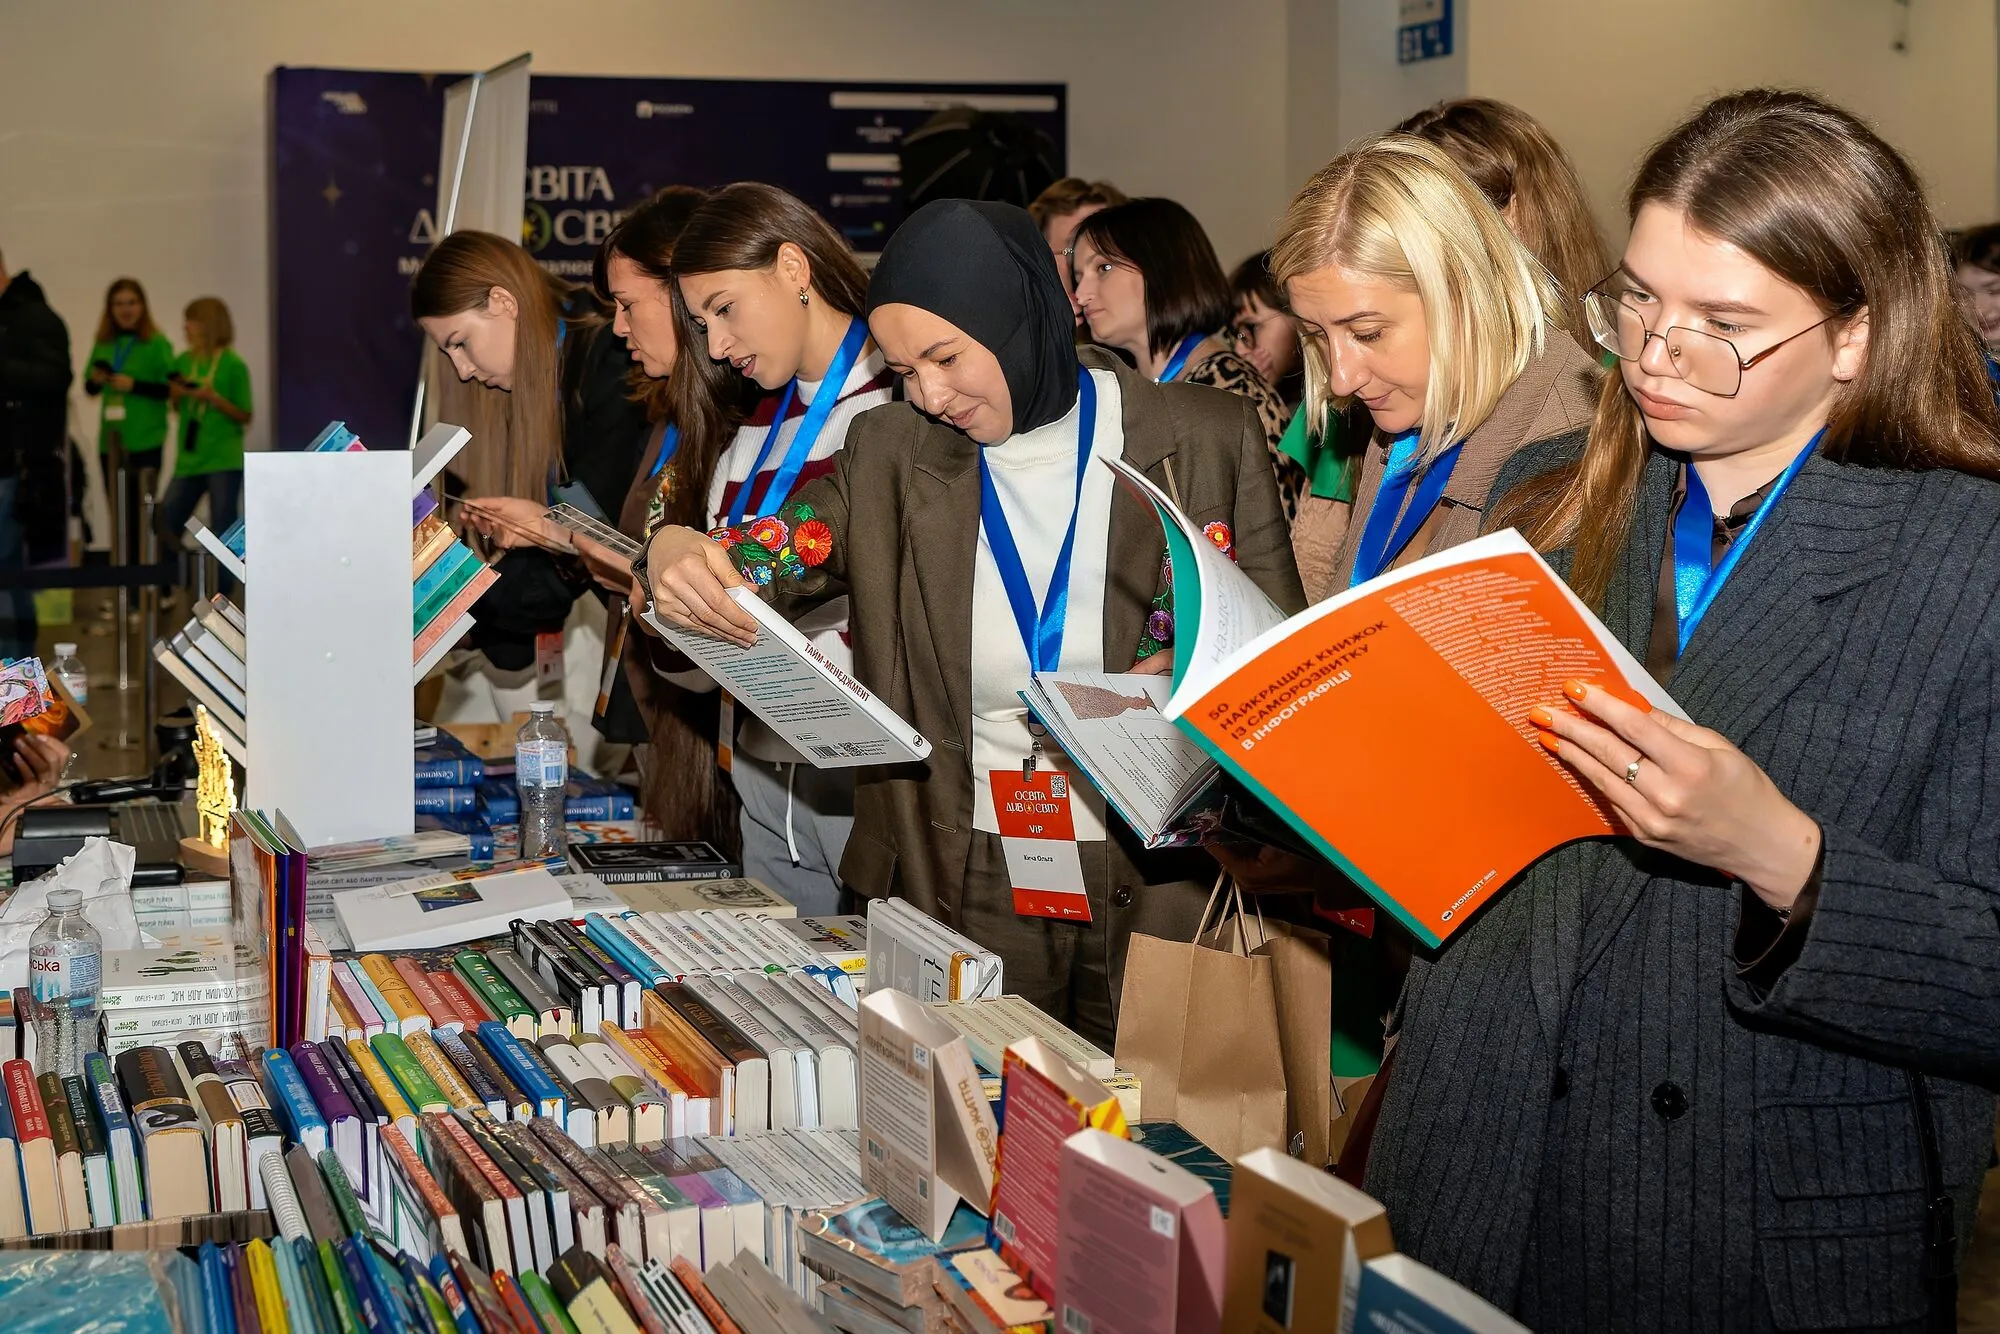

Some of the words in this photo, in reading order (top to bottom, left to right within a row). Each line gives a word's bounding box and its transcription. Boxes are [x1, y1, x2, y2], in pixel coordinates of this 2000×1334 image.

[804, 643, 871, 702] ТАЙМ-МЕНЕДЖМЕНТ
[1219, 659, 1316, 731] НАЙКРАЩИХ
[1315, 621, 1389, 662] КНИЖОК
[1231, 725, 1248, 740] ІЗ
[1247, 644, 1369, 727] САМОРОЗВИТКУ
[1208, 702, 1230, 720] 50
[1241, 738, 1255, 751] В
[1252, 670, 1352, 741] ІНФОГРАФІЦІ
[1015, 790, 1047, 801] ОСВІТА
[1028, 824, 1044, 834] VIP
[596, 871, 636, 882] НАТОМІЯ
[1451, 879, 1485, 911] МОНОЛІТ
[171, 990, 186, 1003] НАС
[187, 989, 202, 1001] ДЛЯ
[204, 987, 234, 1000] ХВИЛИН
[188, 1013, 202, 1026] НАС
[204, 1012, 219, 1025] ДЛЯ
[958, 1079, 984, 1127] ЖИТТЯ
